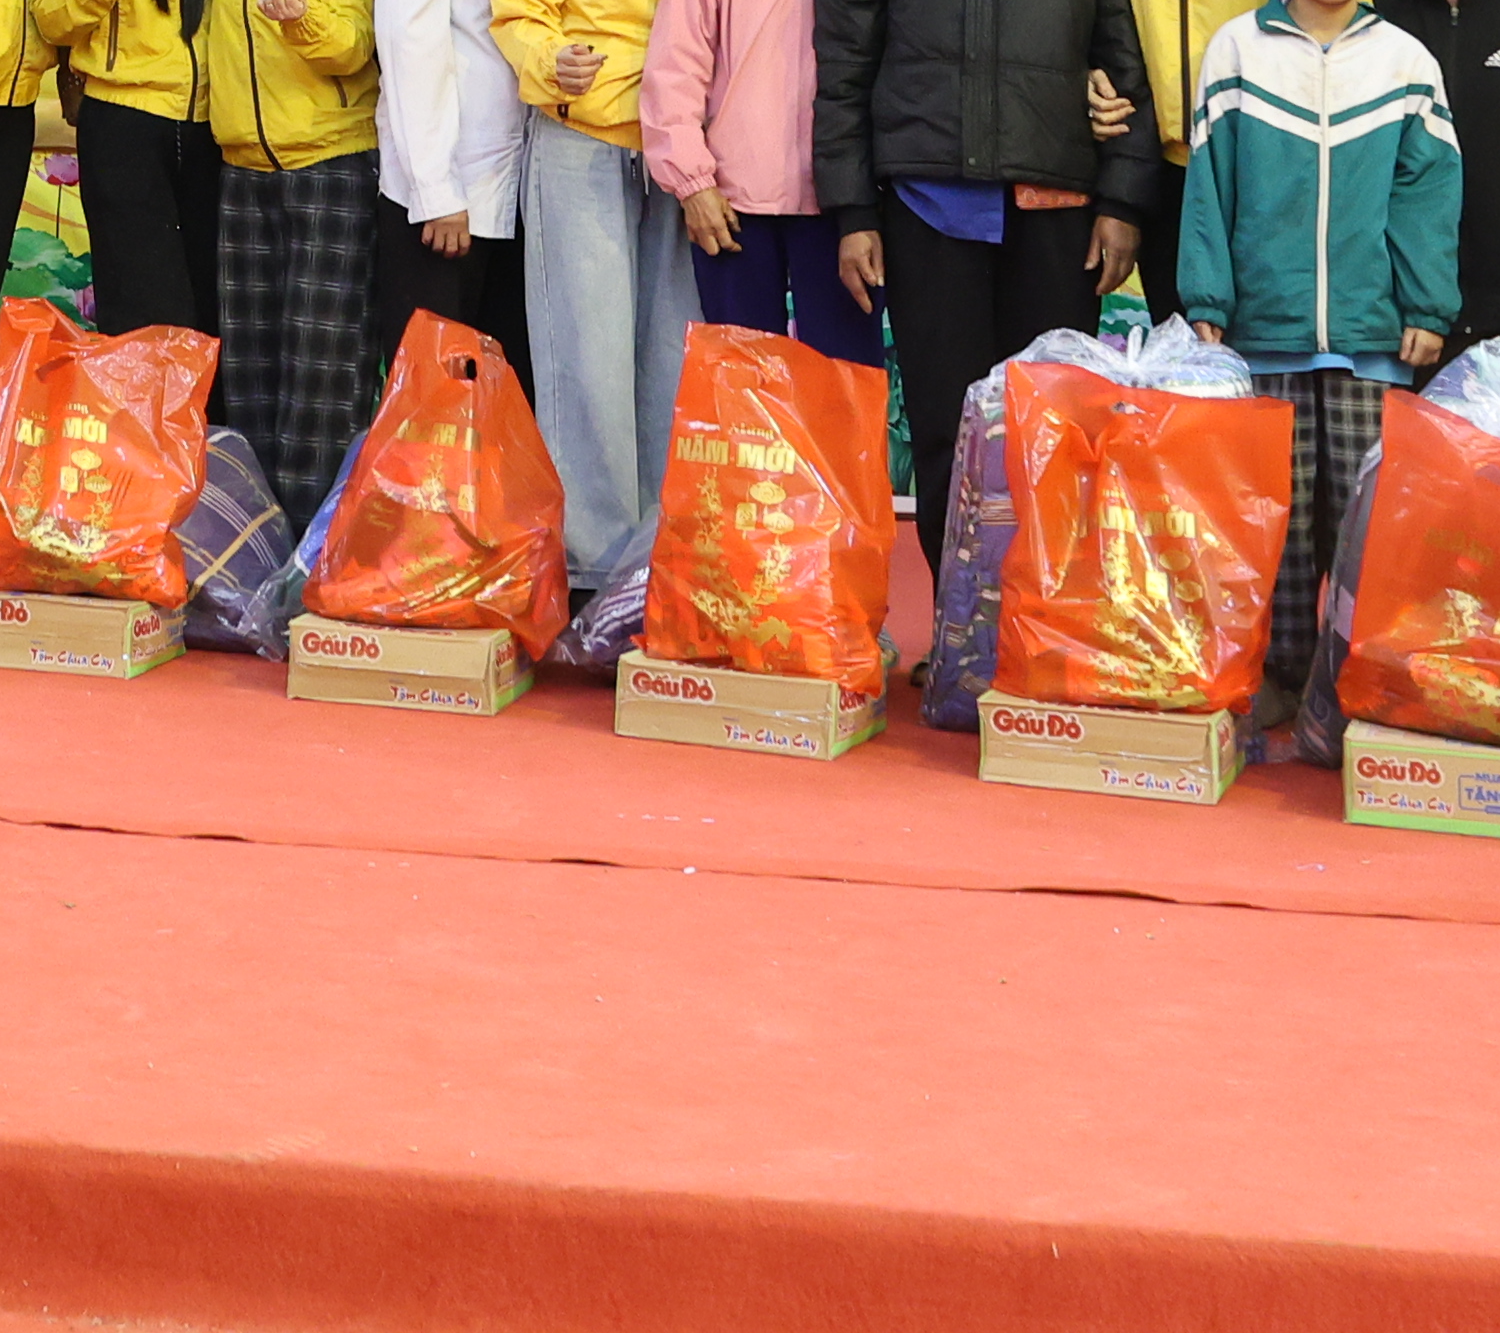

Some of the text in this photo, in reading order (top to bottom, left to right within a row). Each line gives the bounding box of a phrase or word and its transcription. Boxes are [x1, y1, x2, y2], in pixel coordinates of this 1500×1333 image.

[676, 433, 797, 475] NĂM MỚI
[0, 601, 28, 623] Đỏ
[302, 631, 380, 659] Gấu Đỏ
[632, 671, 714, 701] Gấu Đỏ
[994, 709, 1082, 741] Gấu Đỏ
[1357, 756, 1441, 785] Gấu Đỏ
